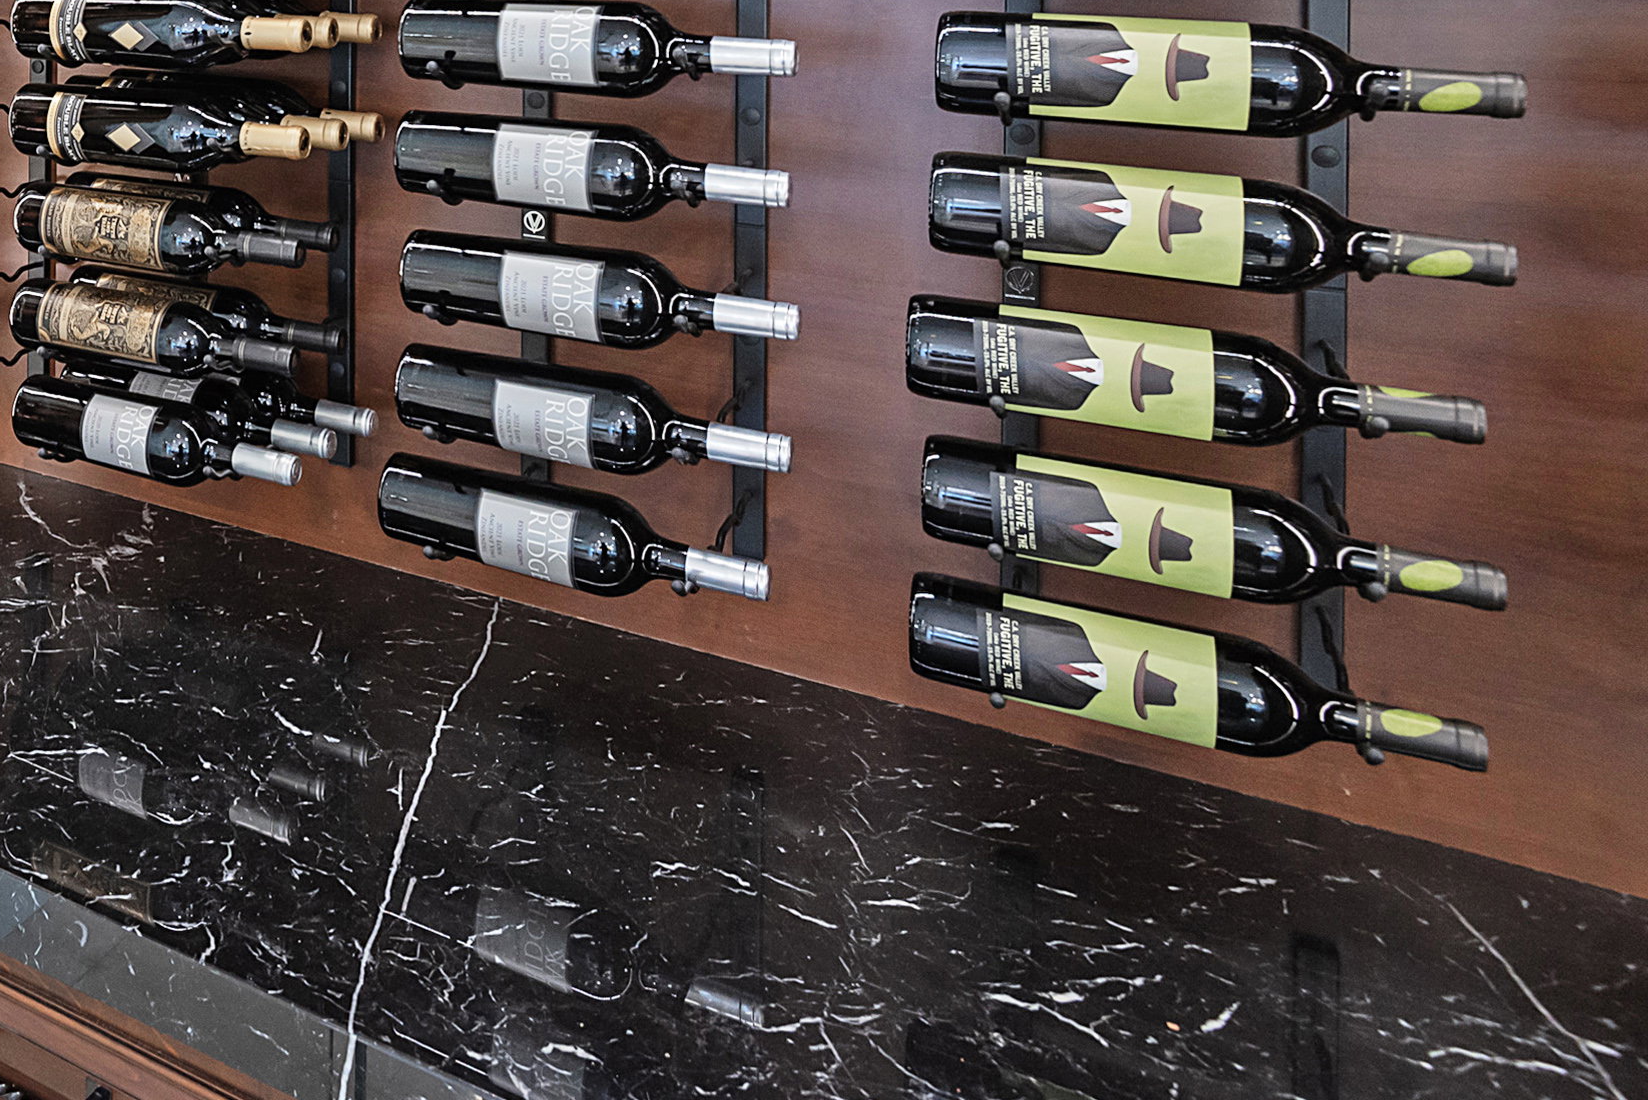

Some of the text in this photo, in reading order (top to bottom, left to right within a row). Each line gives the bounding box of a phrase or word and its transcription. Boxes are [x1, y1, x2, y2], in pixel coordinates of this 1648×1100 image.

[65, 31, 80, 62] BLACK
[549, 10, 572, 81] RIDGE
[570, 6, 595, 52] OAK
[1029, 25, 1043, 93] FUGITIVE, THE
[1042, 49, 1050, 70] CREEK
[1043, 70, 1051, 92] VALLEY
[62, 95, 76, 161] DOUBLE BLACK
[565, 131, 590, 179] OAK
[543, 134, 568, 205] RIDGE
[1023, 170, 1037, 239] FUGITIVE, THE
[1035, 181, 1045, 238] DRY CREEK VALLEY
[552, 266, 576, 337] RIDGE
[573, 262, 597, 314] OAK
[996, 323, 1011, 394] FUGITIVE, THE
[1009, 351, 1017, 372] CREEK
[1011, 373, 1019, 394] VALLEY
[116, 405, 138, 469] RIDGE
[131, 405, 154, 451] OAK
[566, 397, 588, 452] OAK
[547, 510, 571, 565] OAK
[1013, 479, 1029, 550] FUGITIVE, THE
[1026, 496, 1037, 550] DRY CREEK VALLEY
[1000, 616, 1015, 689] FUGITIVE, THE
[1013, 649, 1021, 670] CREEK
[1014, 671, 1023, 690] VALLEY
